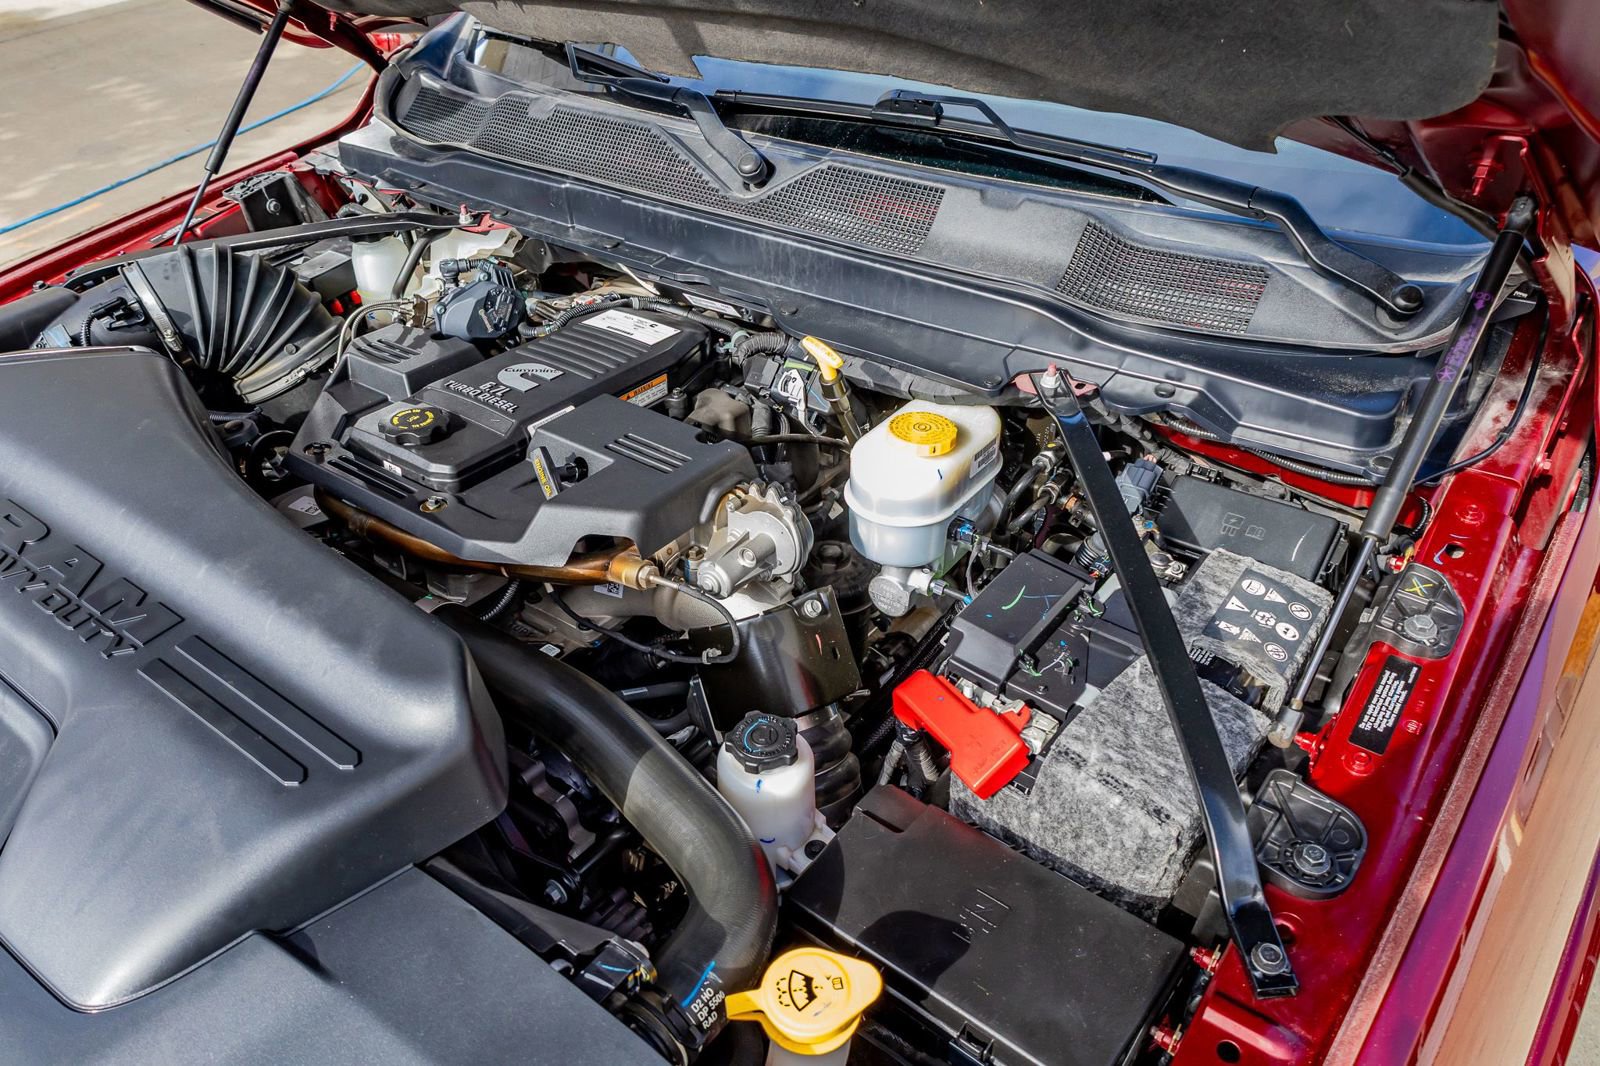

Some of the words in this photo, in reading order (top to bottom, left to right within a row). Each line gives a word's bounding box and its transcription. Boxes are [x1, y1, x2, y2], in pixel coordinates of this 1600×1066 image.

[444, 380, 481, 398] TURBO
[478, 392, 518, 413] DIESEL
[479, 381, 511, 397] 6.7L
[534, 458, 546, 484] ENGINE
[544, 484, 553, 497] OIL
[0, 498, 186, 648] RAM
[32, 588, 138, 659] DUTY
[690, 998, 704, 1013] D2
[700, 987, 714, 1002] HO
[697, 1006, 709, 1021] DP
[708, 990, 725, 1010] 5500
[702, 1011, 718, 1029] RAD
